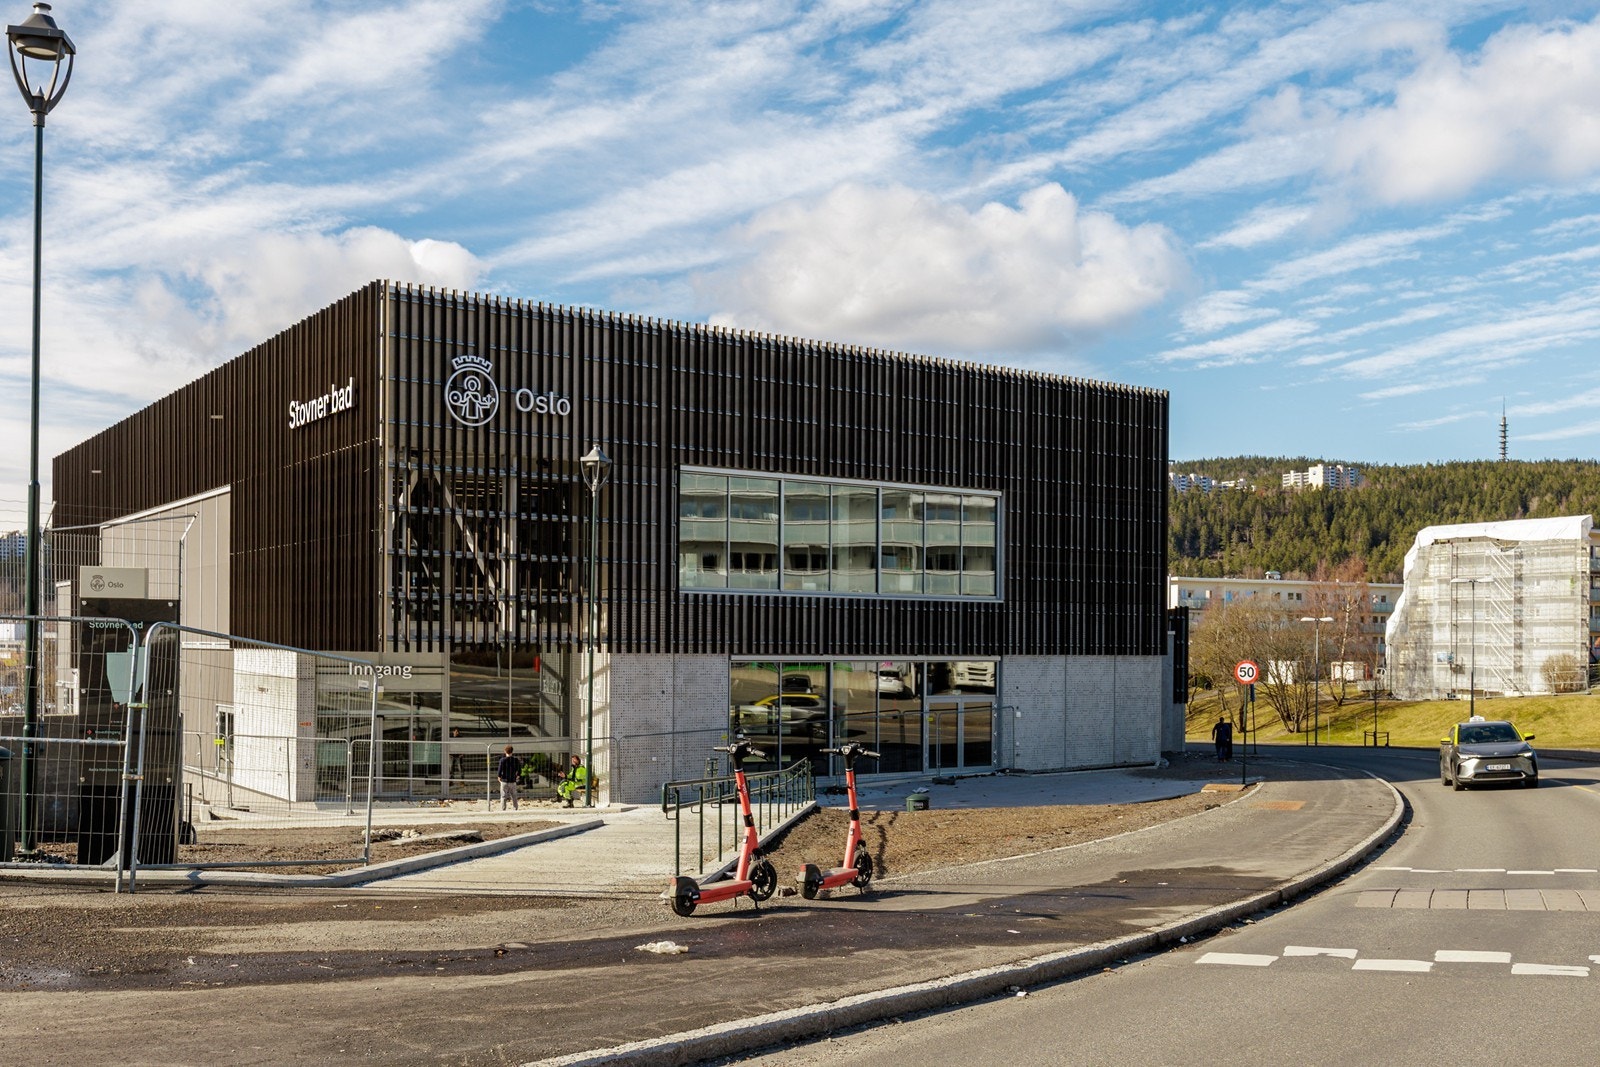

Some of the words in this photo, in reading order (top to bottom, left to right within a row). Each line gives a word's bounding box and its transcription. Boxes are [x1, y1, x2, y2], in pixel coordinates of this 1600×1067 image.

[289, 393, 330, 430] Stovner
[331, 377, 353, 414] bad
[515, 388, 571, 416] Oslo
[89, 620, 125, 629] Stovner
[349, 662, 412, 679] Inngang
[1239, 666, 1255, 678] 50
